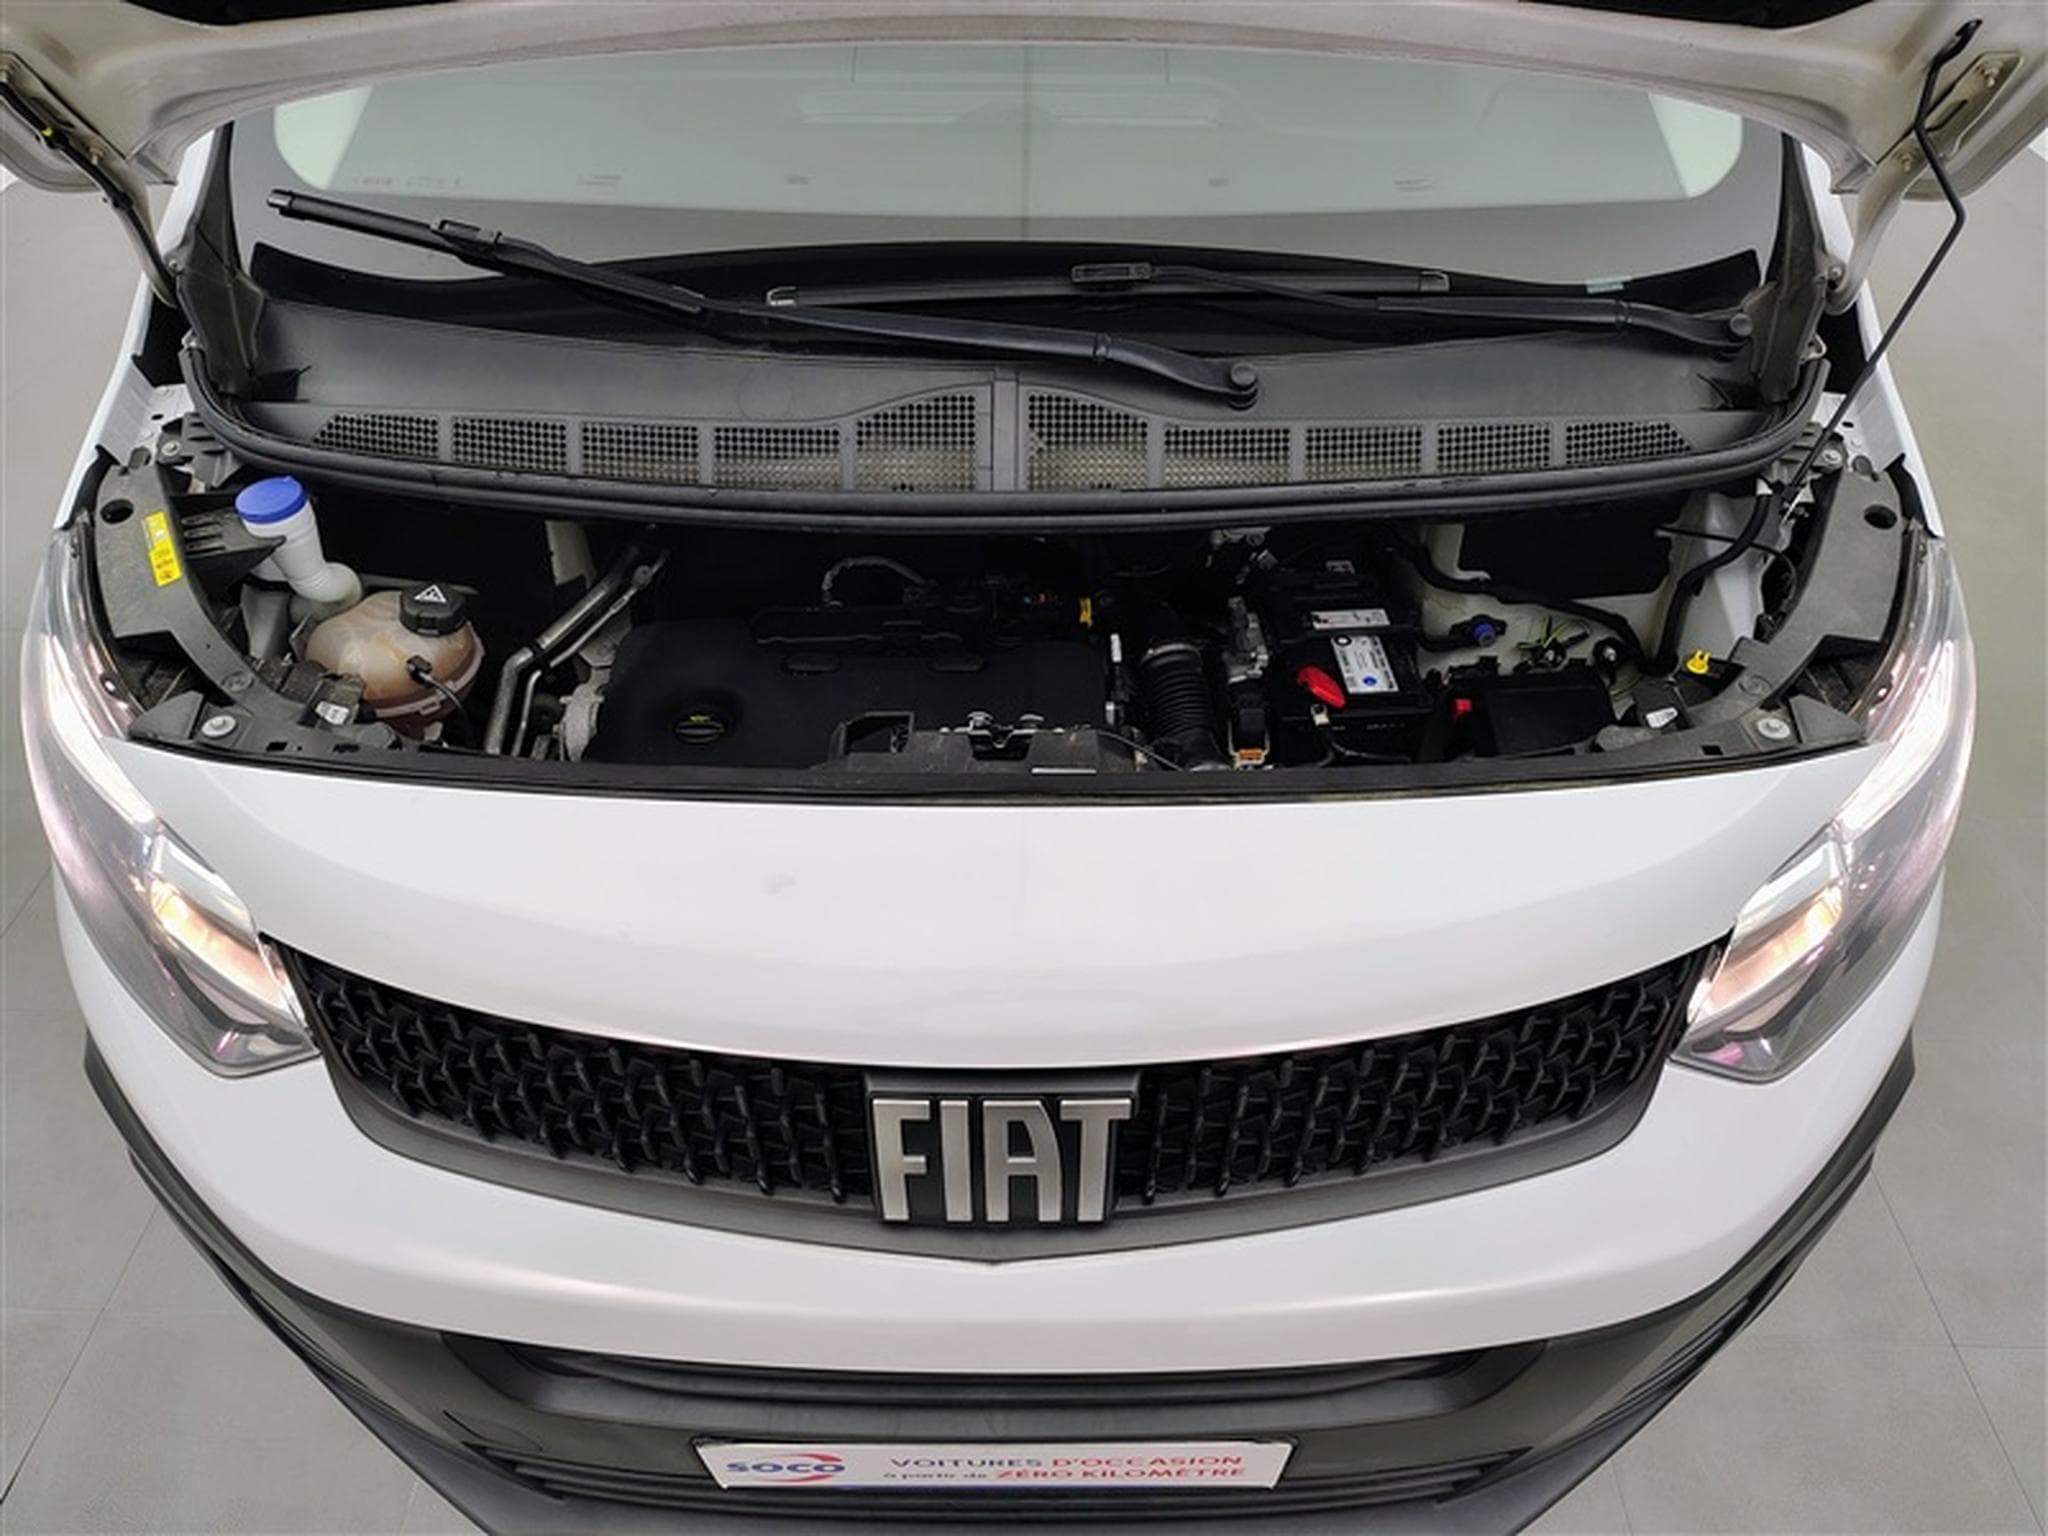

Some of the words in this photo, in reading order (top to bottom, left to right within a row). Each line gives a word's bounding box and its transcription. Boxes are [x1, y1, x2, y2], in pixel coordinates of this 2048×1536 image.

[873, 1098, 1131, 1221] FIAT
[727, 1462, 846, 1473] SOCO
[891, 1459, 1042, 1468] VOITURES
[1052, 1456, 1242, 1467] D'OCCASION
